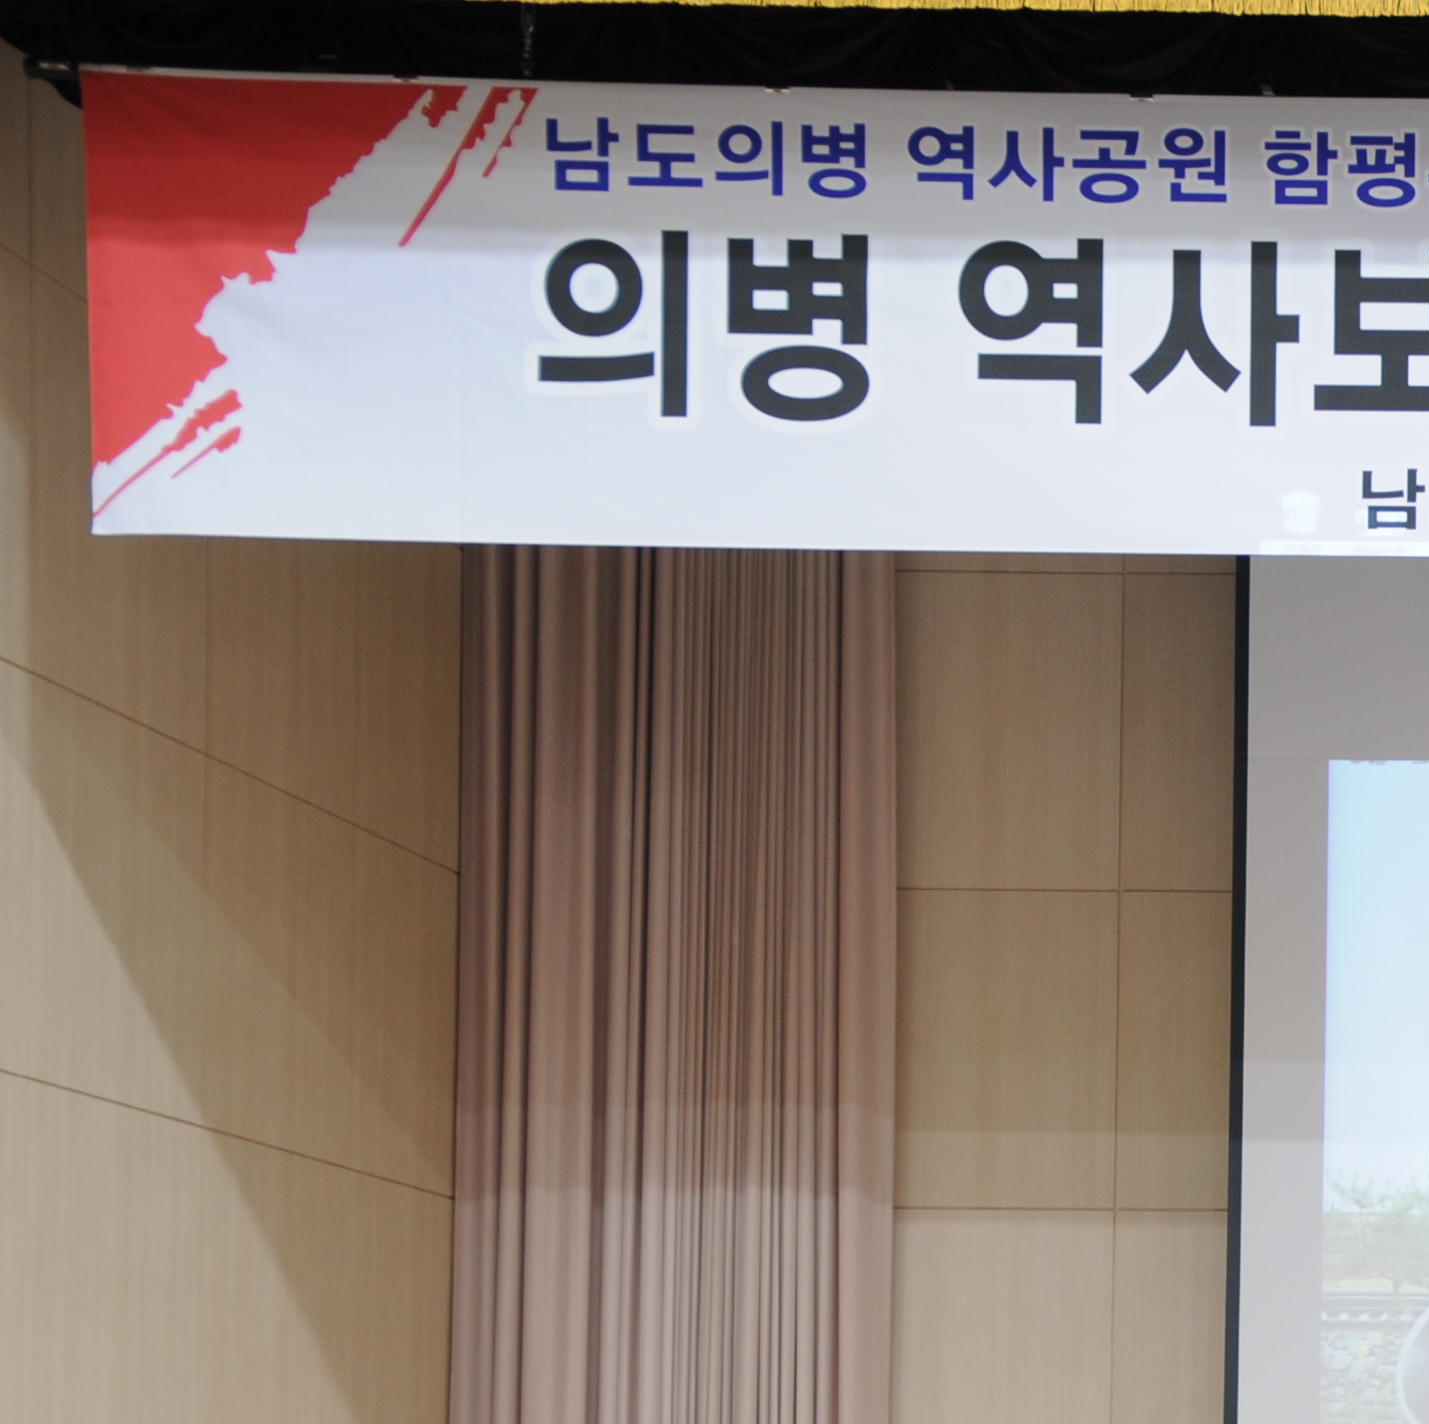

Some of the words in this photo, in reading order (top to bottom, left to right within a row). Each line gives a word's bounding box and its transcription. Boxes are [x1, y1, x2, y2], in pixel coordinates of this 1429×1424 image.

[546, 117, 866, 198] 남도의병
[908, 126, 1226, 203] 역사공원
[538, 229, 869, 421] 의병
